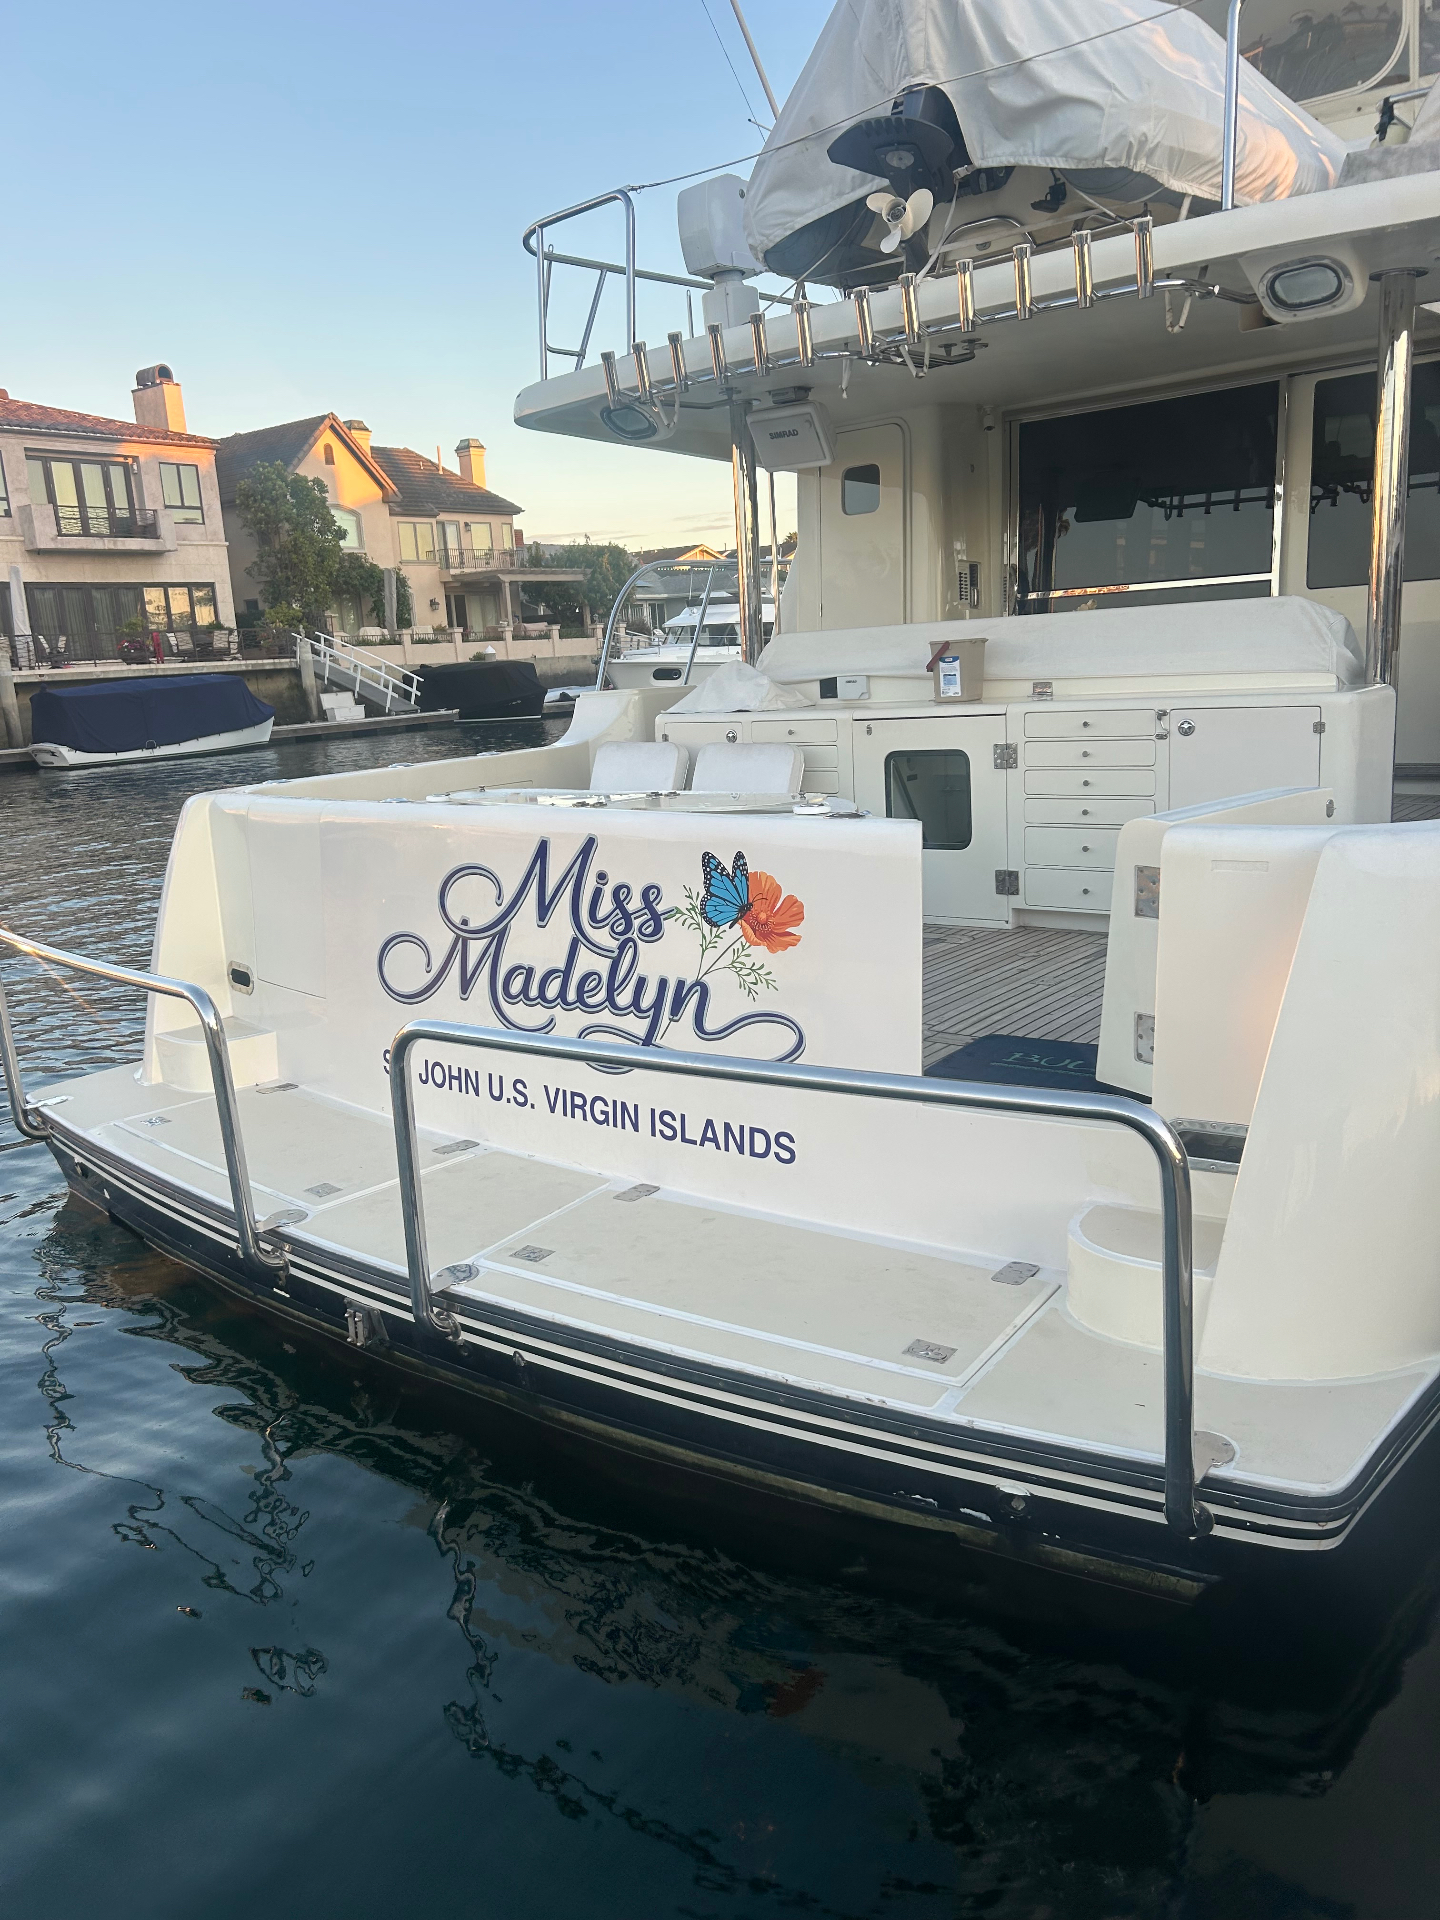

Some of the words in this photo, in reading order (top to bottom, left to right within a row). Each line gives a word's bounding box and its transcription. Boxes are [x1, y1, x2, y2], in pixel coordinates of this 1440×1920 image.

[769, 429, 799, 440] SIMRAD
[438, 833, 677, 955] Miss
[377, 915, 806, 1074] Madelyn
[418, 1058, 480, 1098] JOHN
[488, 1073, 536, 1110] U.S.
[543, 1084, 640, 1133] VIRGIN
[650, 1107, 796, 1165] ISLANDS
